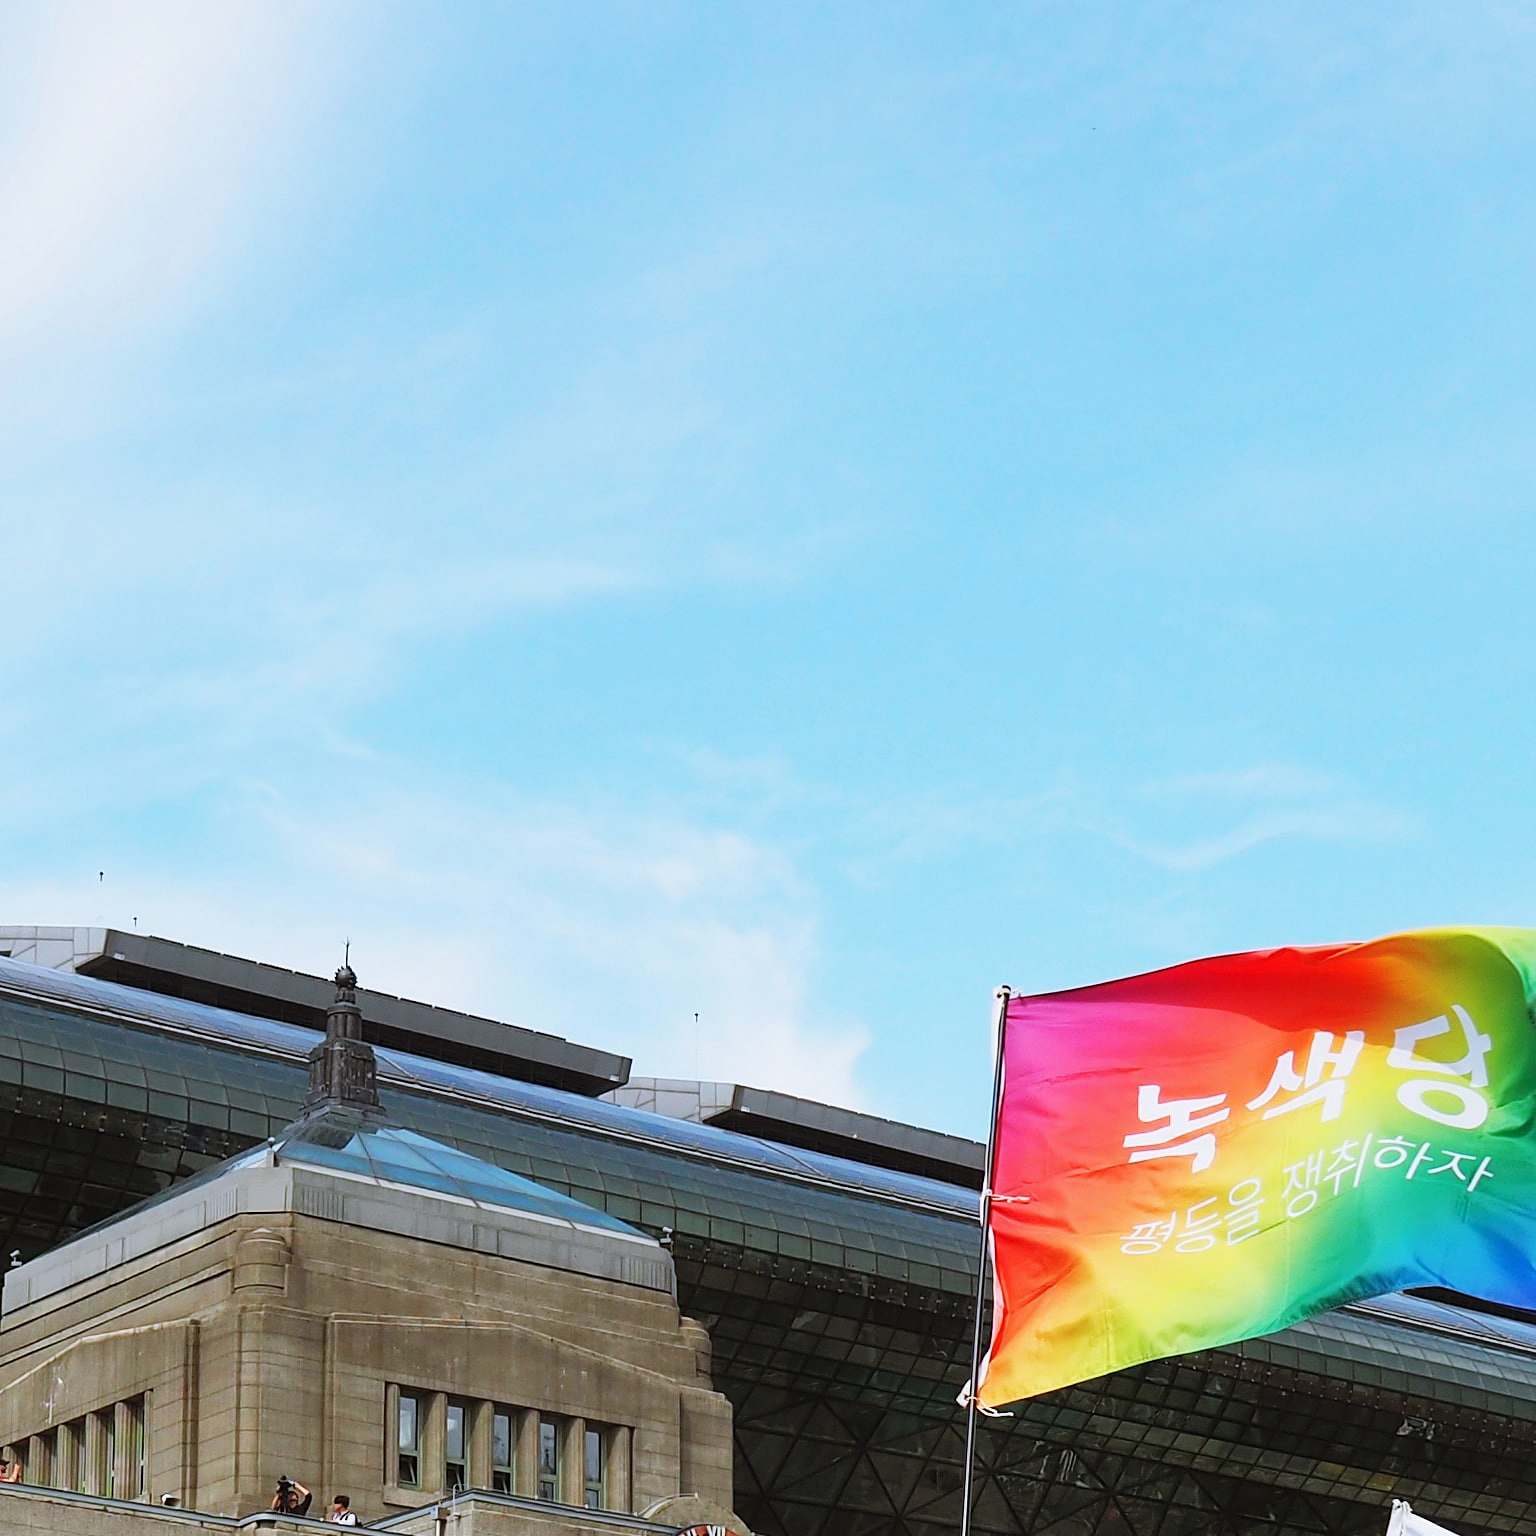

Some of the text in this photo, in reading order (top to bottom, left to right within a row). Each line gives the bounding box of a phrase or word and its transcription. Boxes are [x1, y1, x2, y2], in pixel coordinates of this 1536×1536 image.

[1122, 1003, 1495, 1175] 녹색당
[1119, 1132, 1496, 1257] 평등을 쟁취하자
